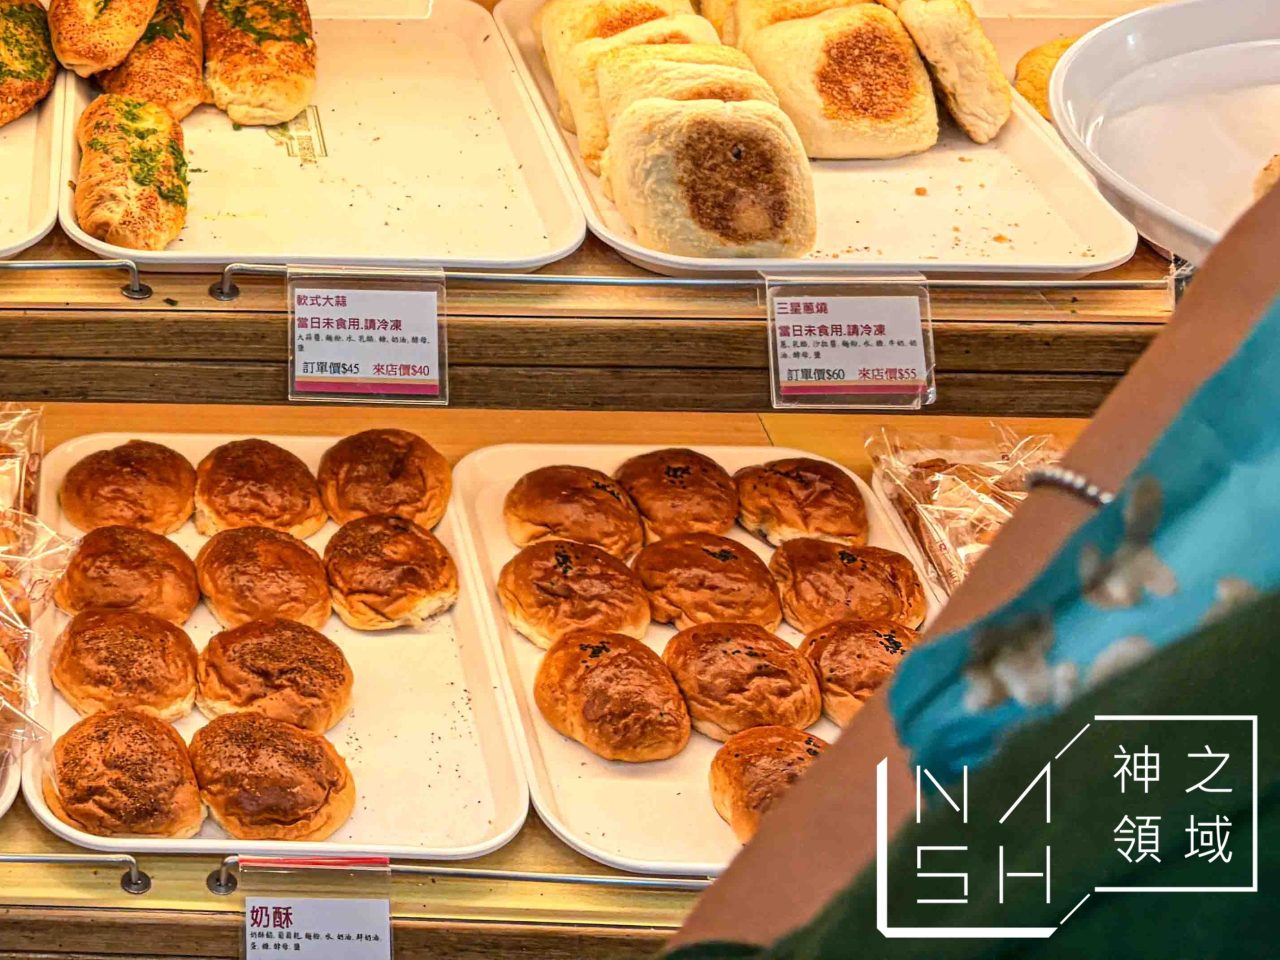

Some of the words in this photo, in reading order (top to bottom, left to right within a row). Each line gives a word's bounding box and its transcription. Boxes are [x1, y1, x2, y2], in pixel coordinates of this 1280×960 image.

[296, 294, 347, 307] 軟式大蒜
[302, 361, 360, 374] 訂單價$45
[373, 363, 430, 376] 來店價$40
[787, 368, 846, 381] 訂單價$60
[858, 368, 917, 380] 來店價$55
[250, 906, 293, 929] 奶酥
